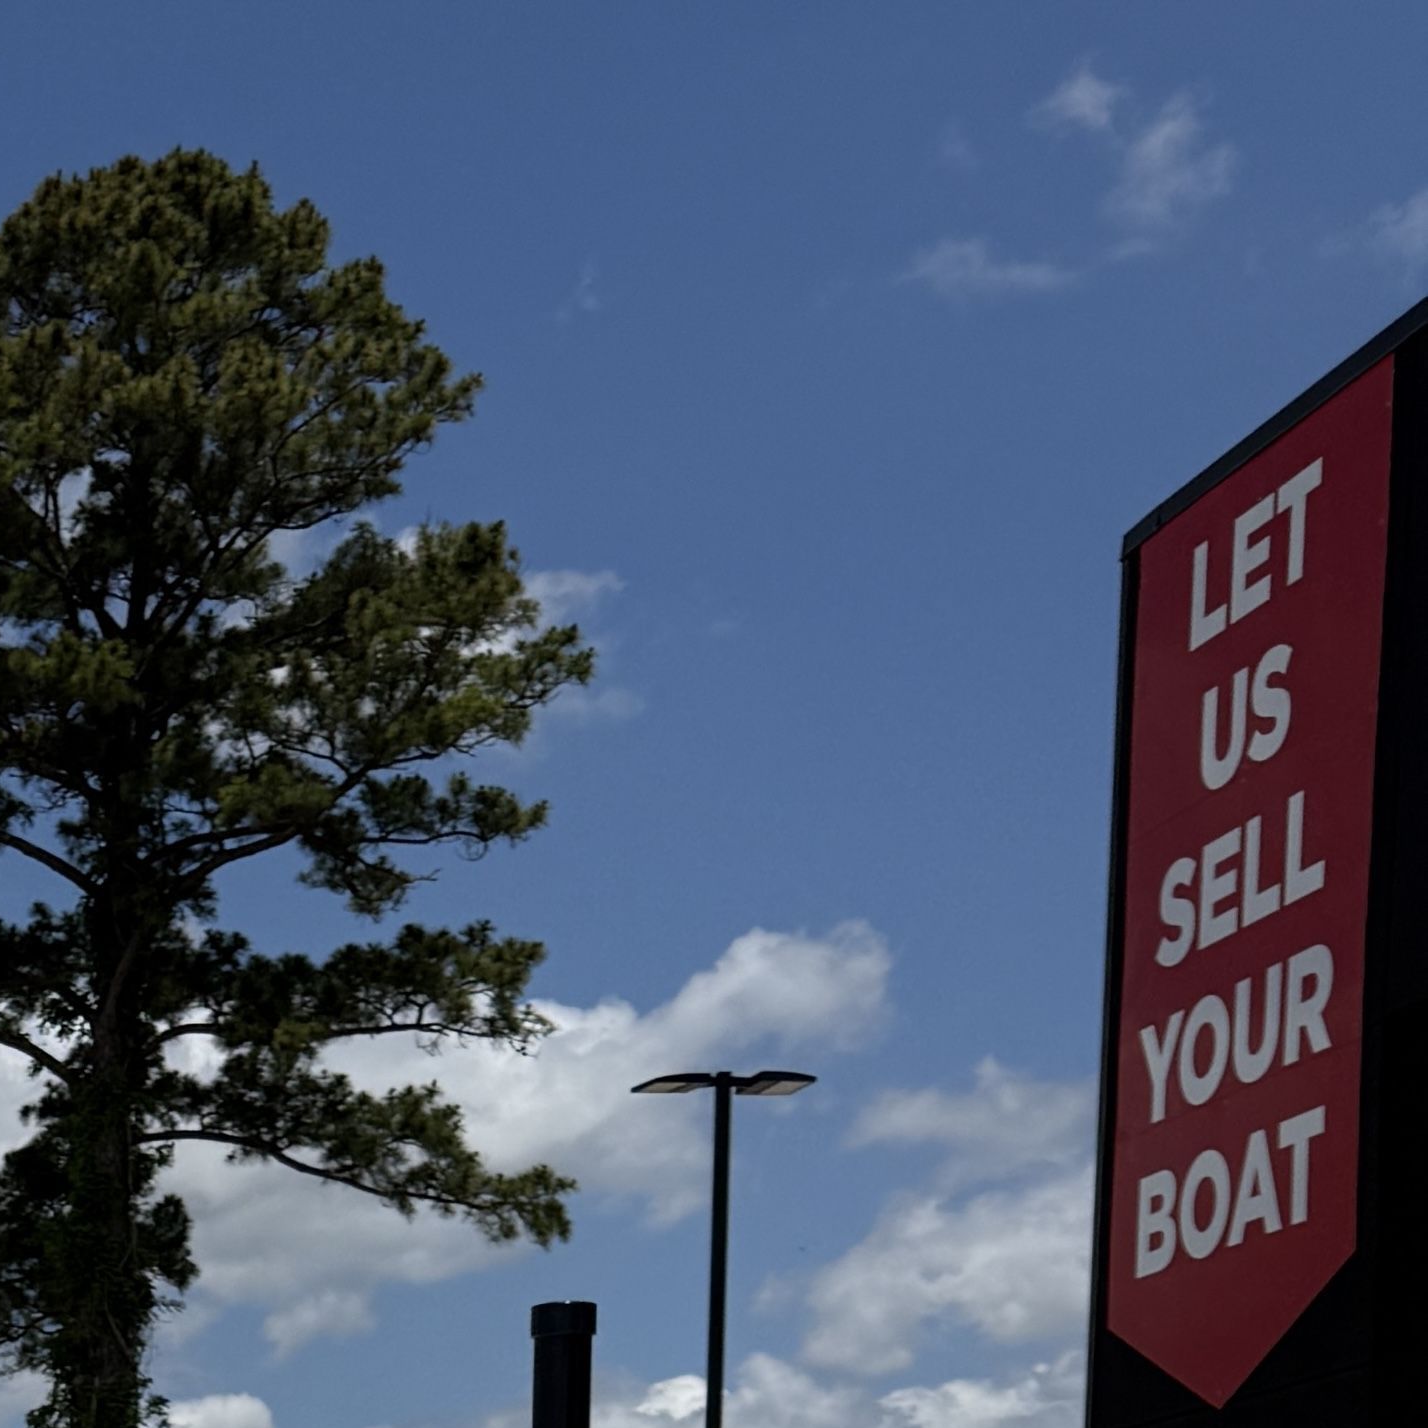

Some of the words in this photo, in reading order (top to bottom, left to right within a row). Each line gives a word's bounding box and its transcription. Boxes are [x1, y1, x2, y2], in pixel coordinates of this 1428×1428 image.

[1187, 456, 1324, 652] LET
[1199, 643, 1293, 791] US
[1154, 789, 1326, 968] SELL
[1138, 943, 1334, 1125] YOUR
[1134, 1105, 1327, 1279] BOAT
